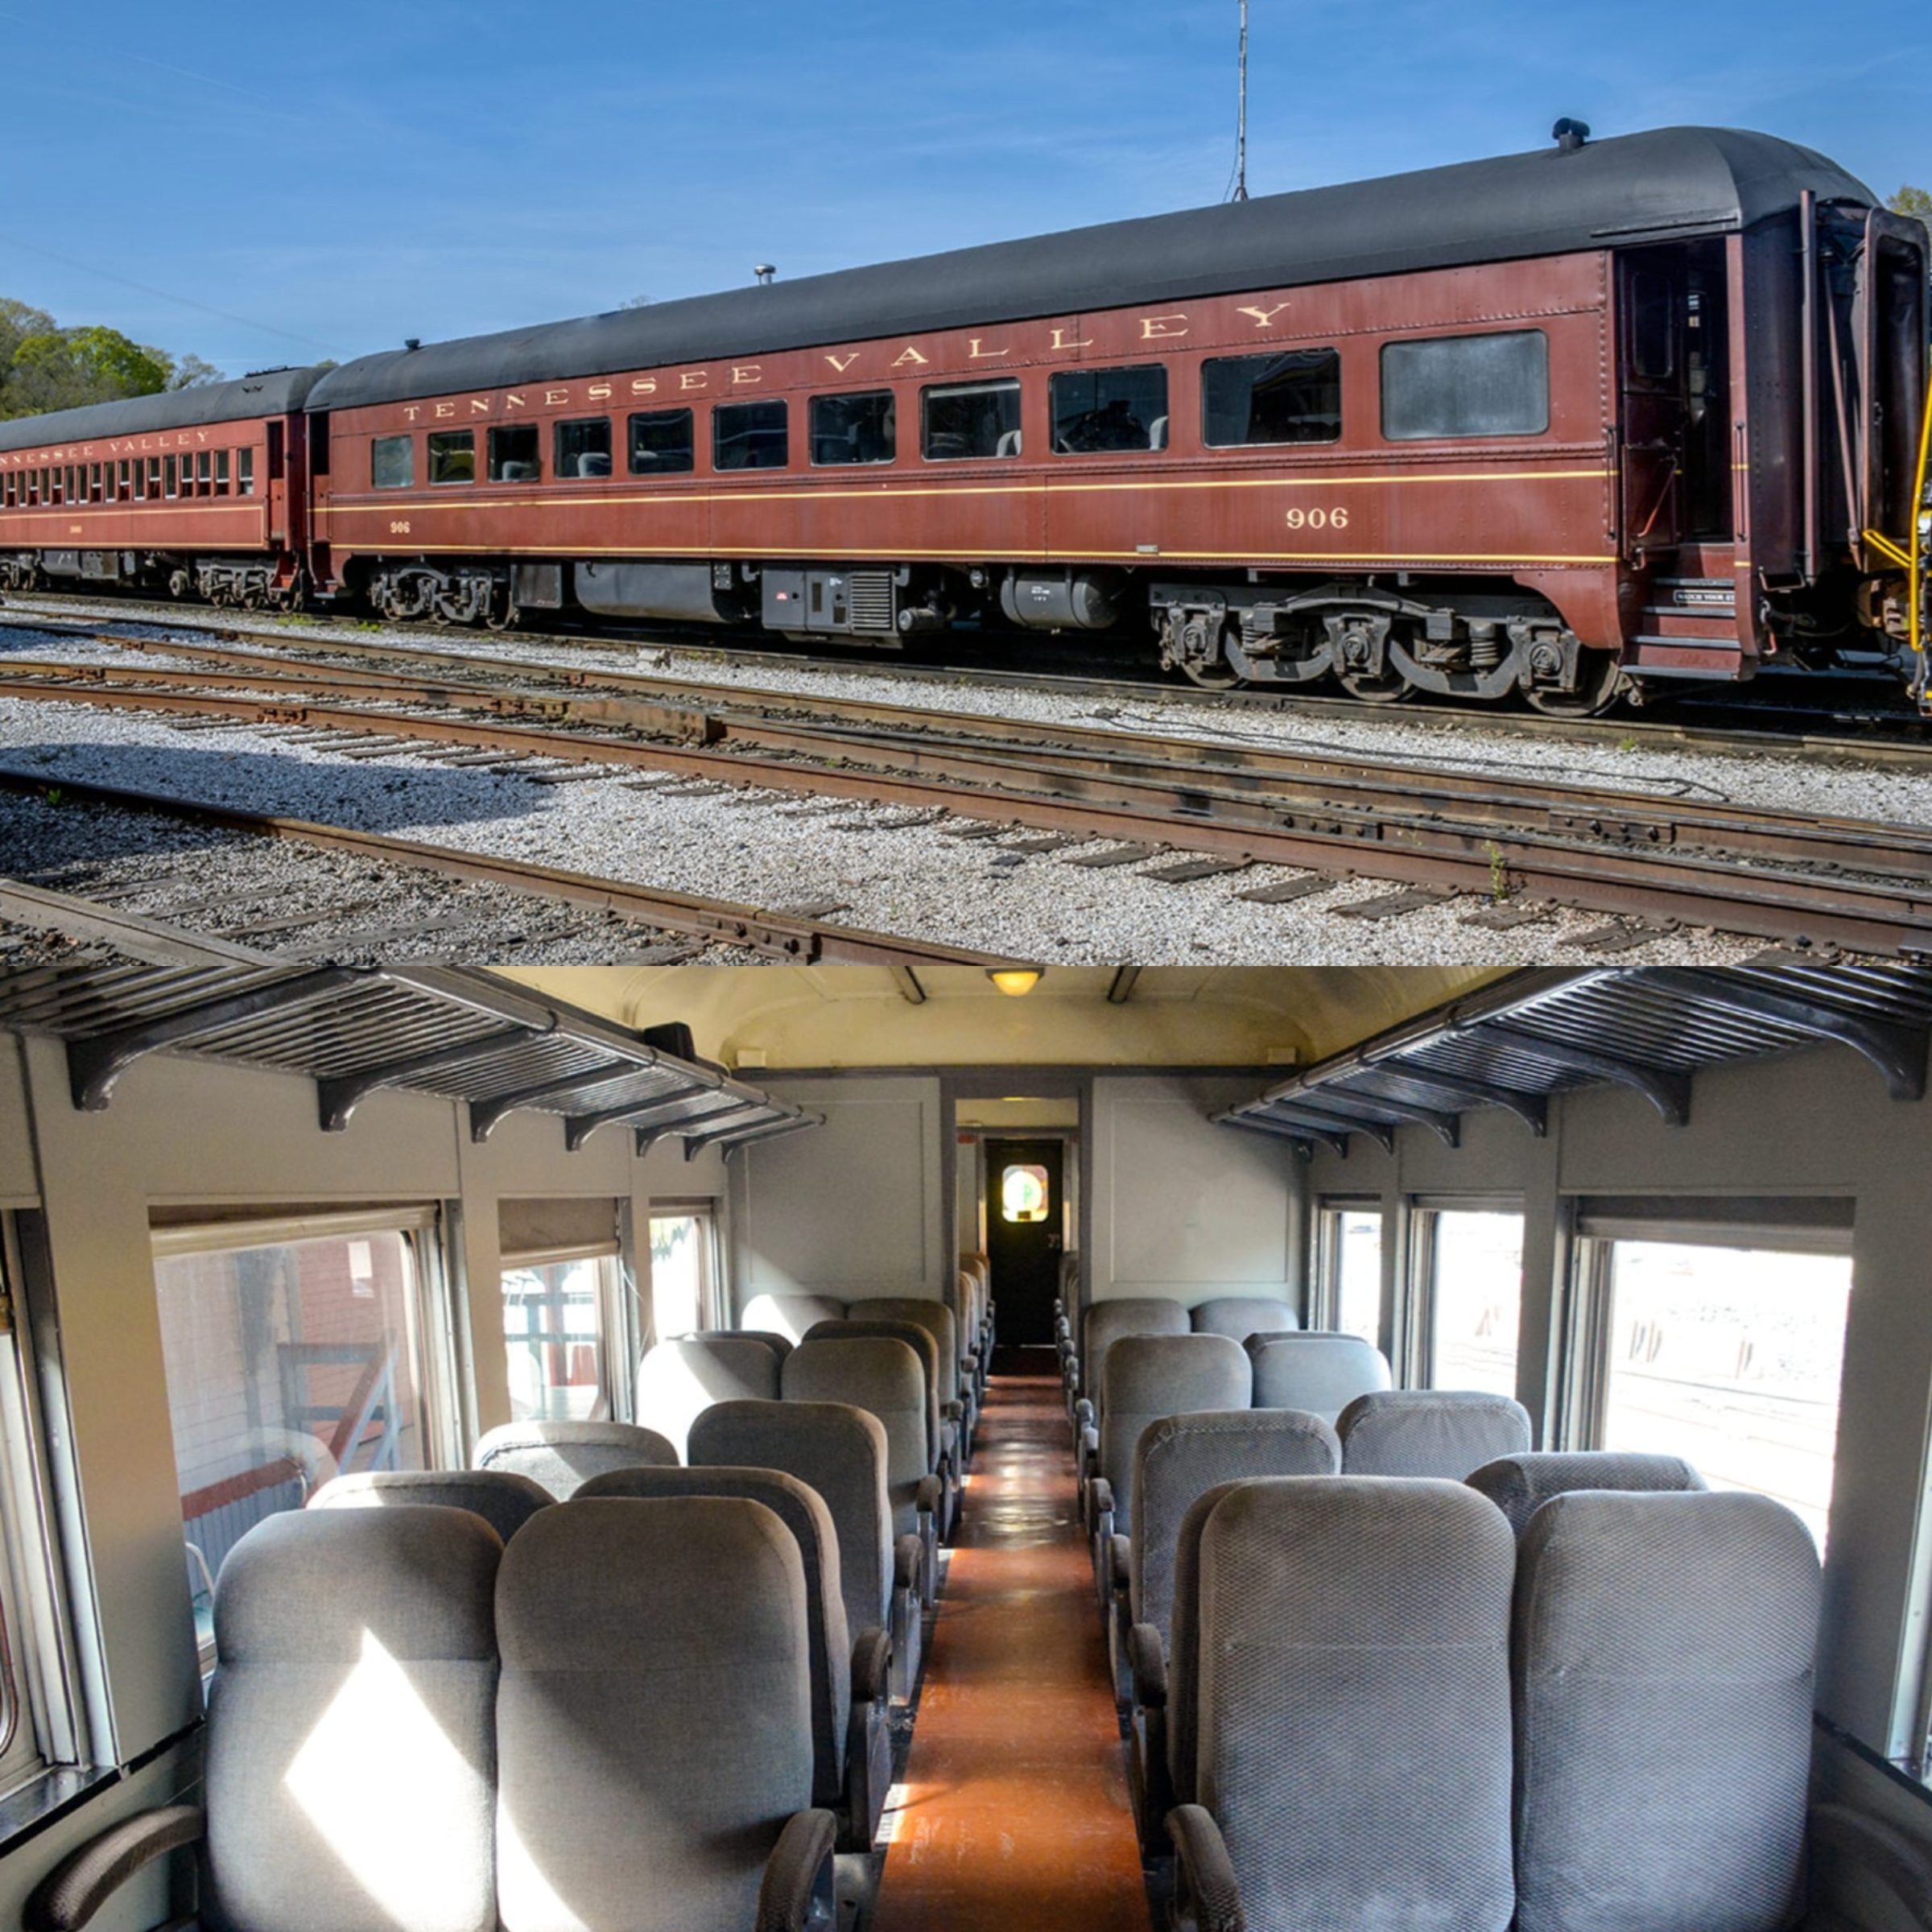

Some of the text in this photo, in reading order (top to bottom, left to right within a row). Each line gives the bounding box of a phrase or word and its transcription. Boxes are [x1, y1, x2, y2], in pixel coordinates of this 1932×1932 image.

[403, 303, 1291, 421] TENNESSEE VALLEY
[109, 431, 208, 452] VALLEY
[390, 521, 411, 534] 906
[1286, 506, 1348, 530] 906
